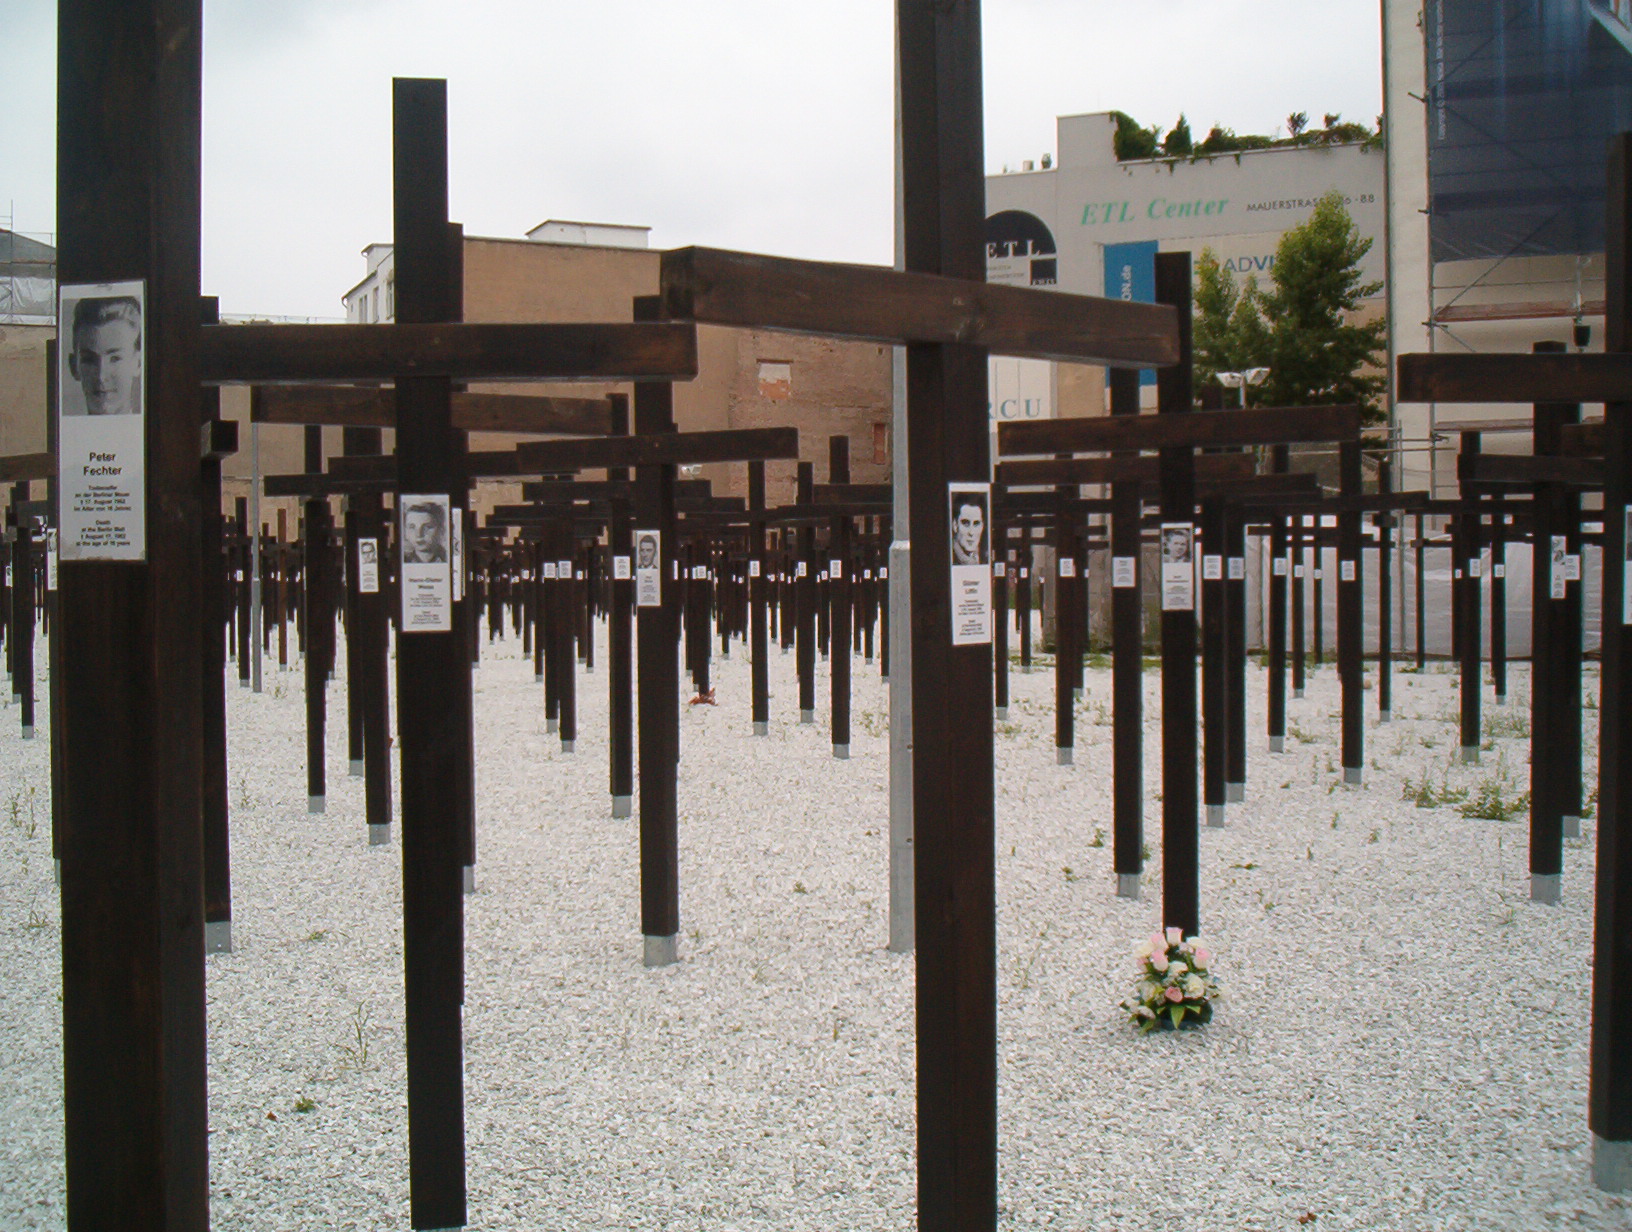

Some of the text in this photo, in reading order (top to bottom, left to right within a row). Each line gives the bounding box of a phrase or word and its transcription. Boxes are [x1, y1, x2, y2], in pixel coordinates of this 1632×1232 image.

[1080, 198, 1229, 225] ETL Center
[986, 239, 1041, 261] ETL
[89, 452, 116, 461] Peter
[83, 465, 122, 476] Fechter
